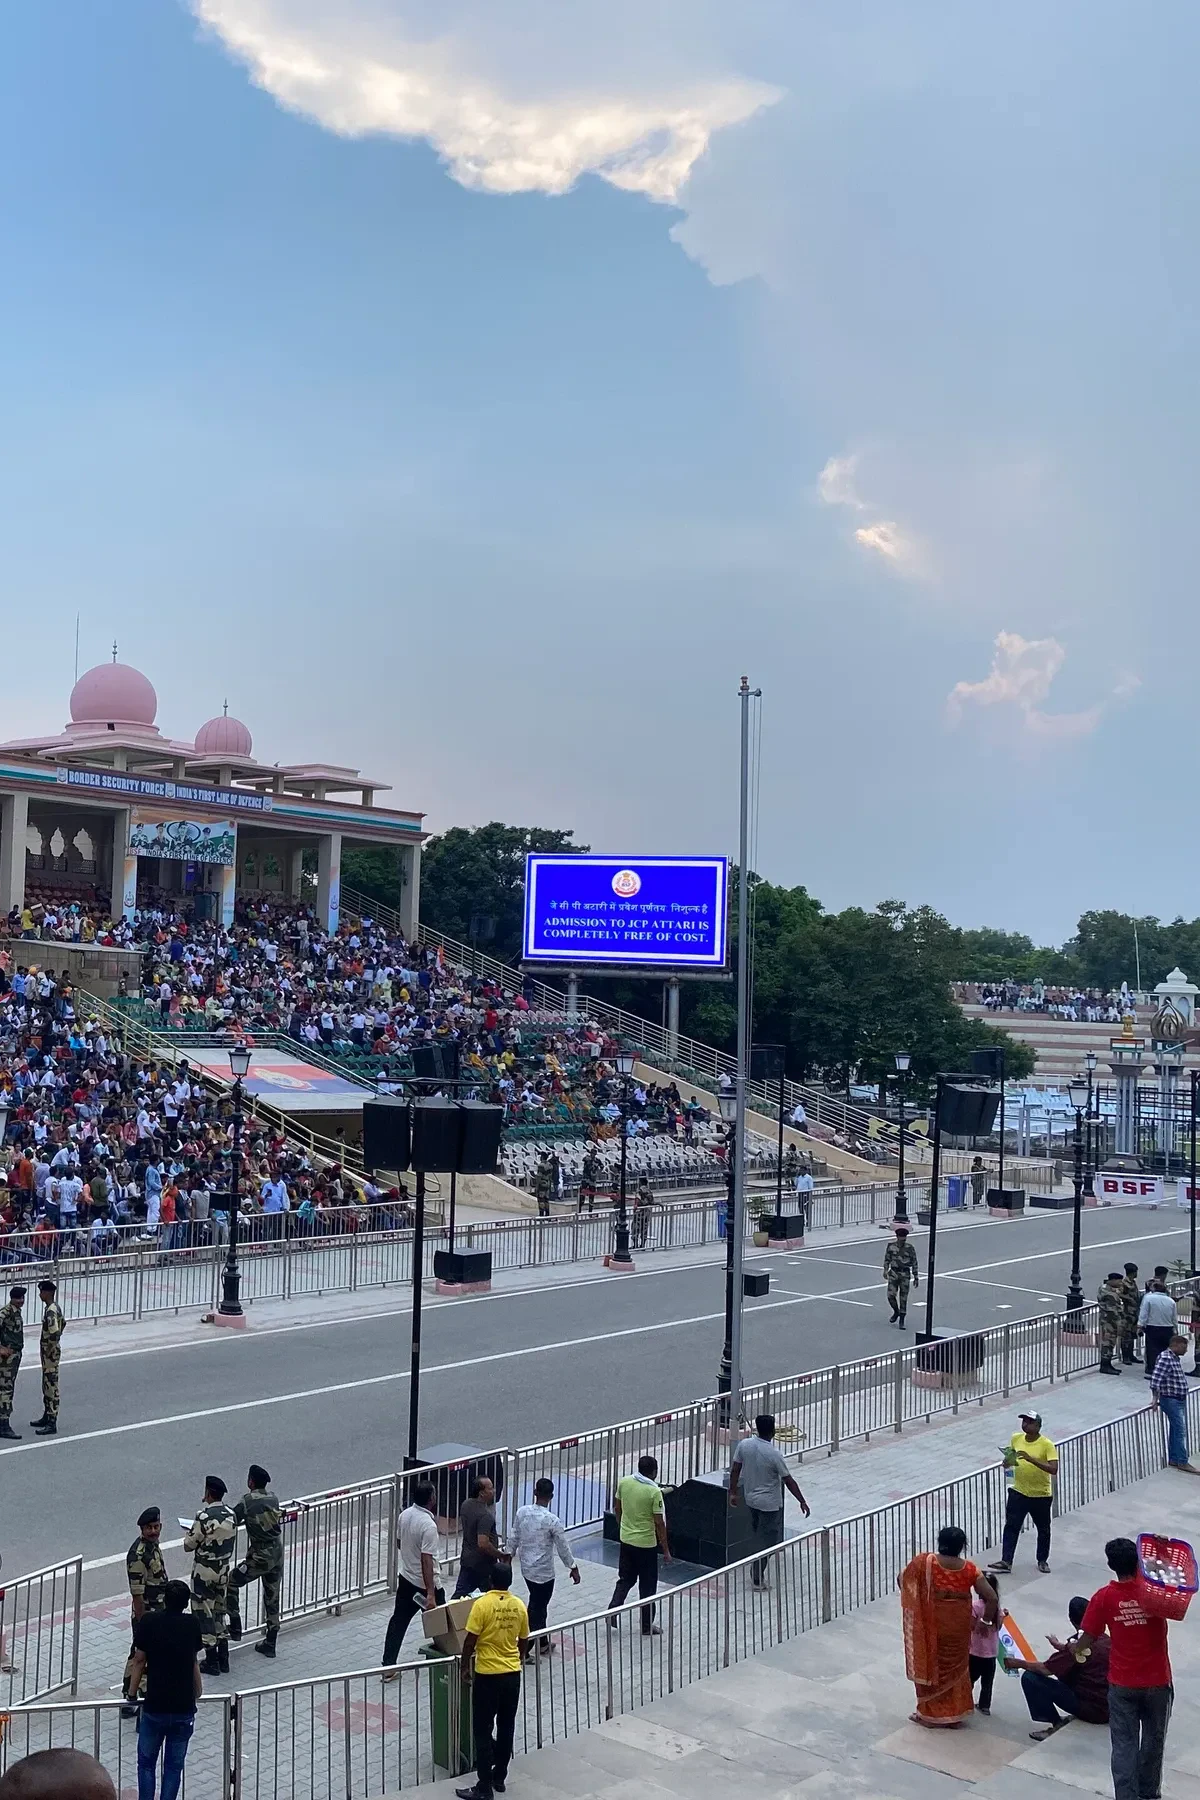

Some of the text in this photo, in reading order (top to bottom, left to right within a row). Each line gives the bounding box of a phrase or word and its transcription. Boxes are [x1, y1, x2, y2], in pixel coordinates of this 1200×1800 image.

[69, 770, 263, 808] BORDER SECURITY FORCE INDIA'S FIRST LINE OF DEFENCE
[146, 848, 168, 858] INDIA'S
[169, 852, 185, 860] FIRST
[187, 853, 200, 861] LINE
[550, 900, 557, 910] जे
[559, 901, 569, 910] सी
[572, 901, 581, 911] पी
[583, 901, 607, 911] अटारी
[619, 903, 638, 911] प्रवेश
[701, 903, 708, 914] है
[544, 918, 709, 930] ADMISSION TO JCP ATTARI IS
[543, 929, 709, 943] COMPLETELY FREE OF COST.
[1103, 1179, 1156, 1196] BSF
